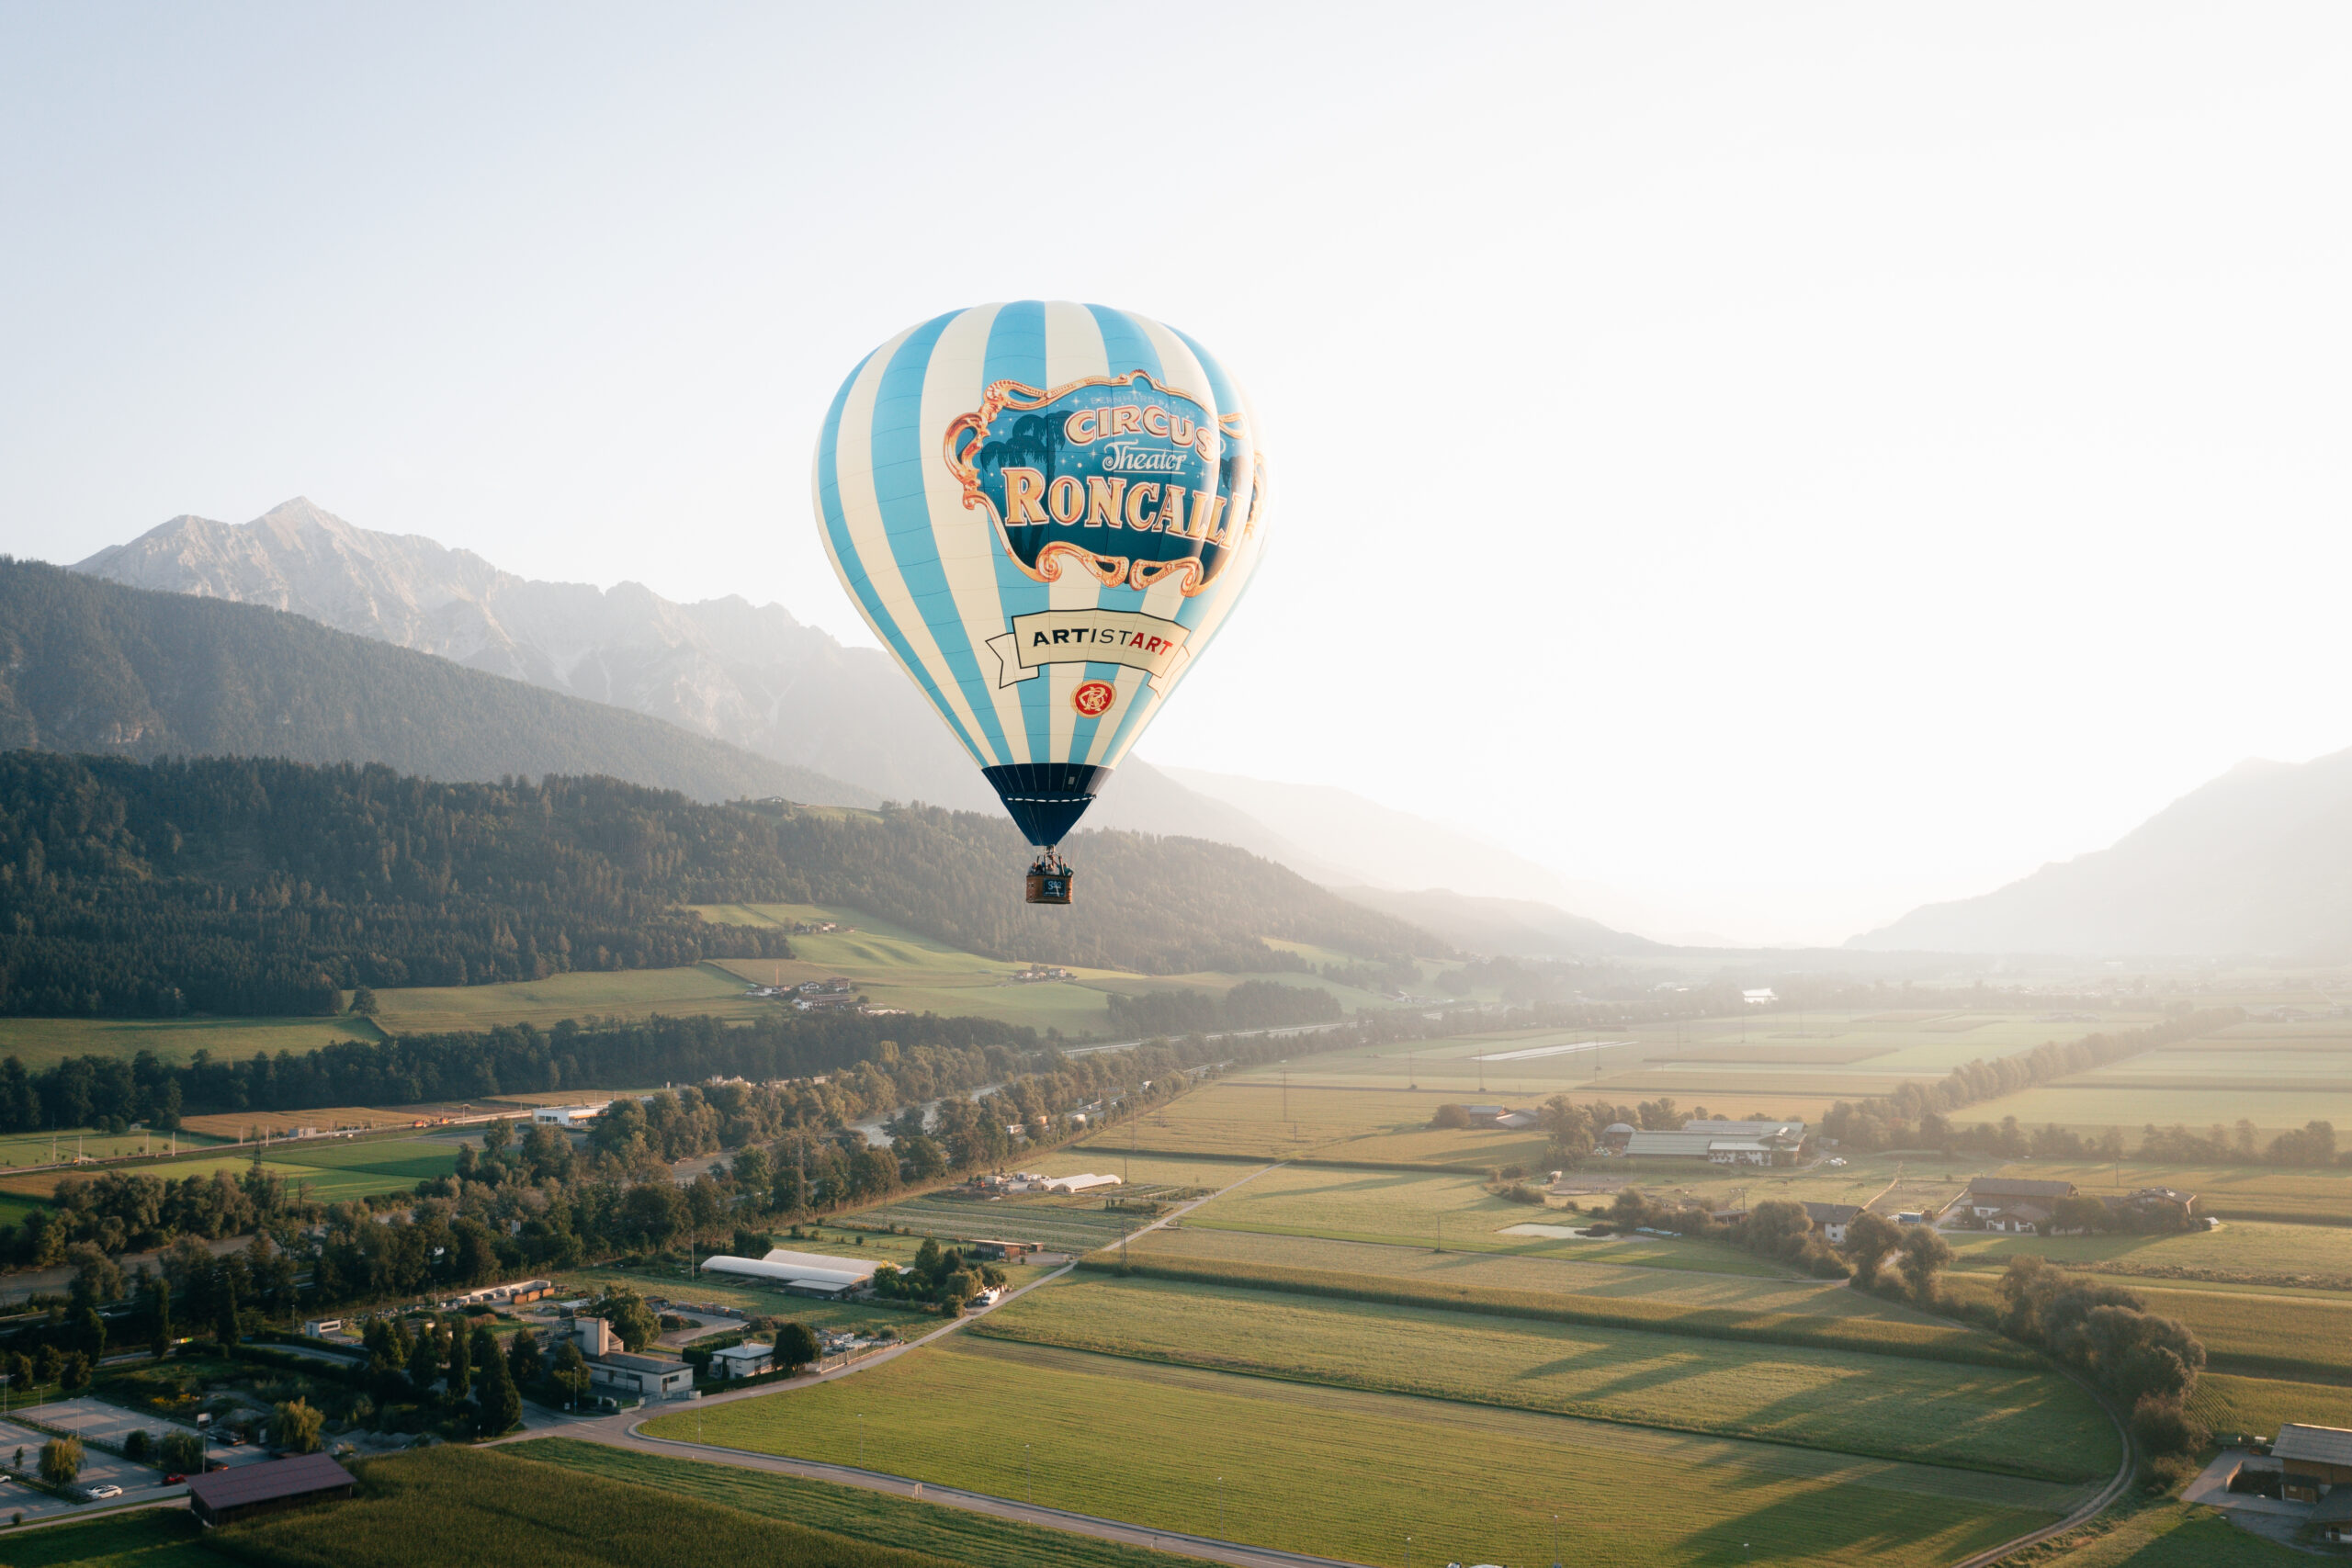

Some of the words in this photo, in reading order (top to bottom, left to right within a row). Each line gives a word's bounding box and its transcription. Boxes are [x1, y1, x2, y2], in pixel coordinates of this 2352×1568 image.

[1091, 395, 1155, 405] BERNHARD
[1064, 404, 1216, 463] CIRCUS
[1102, 438, 1187, 472] Theater
[1001, 467, 1244, 549] RONCALLI
[1033, 628, 1174, 657] ARTISTART
